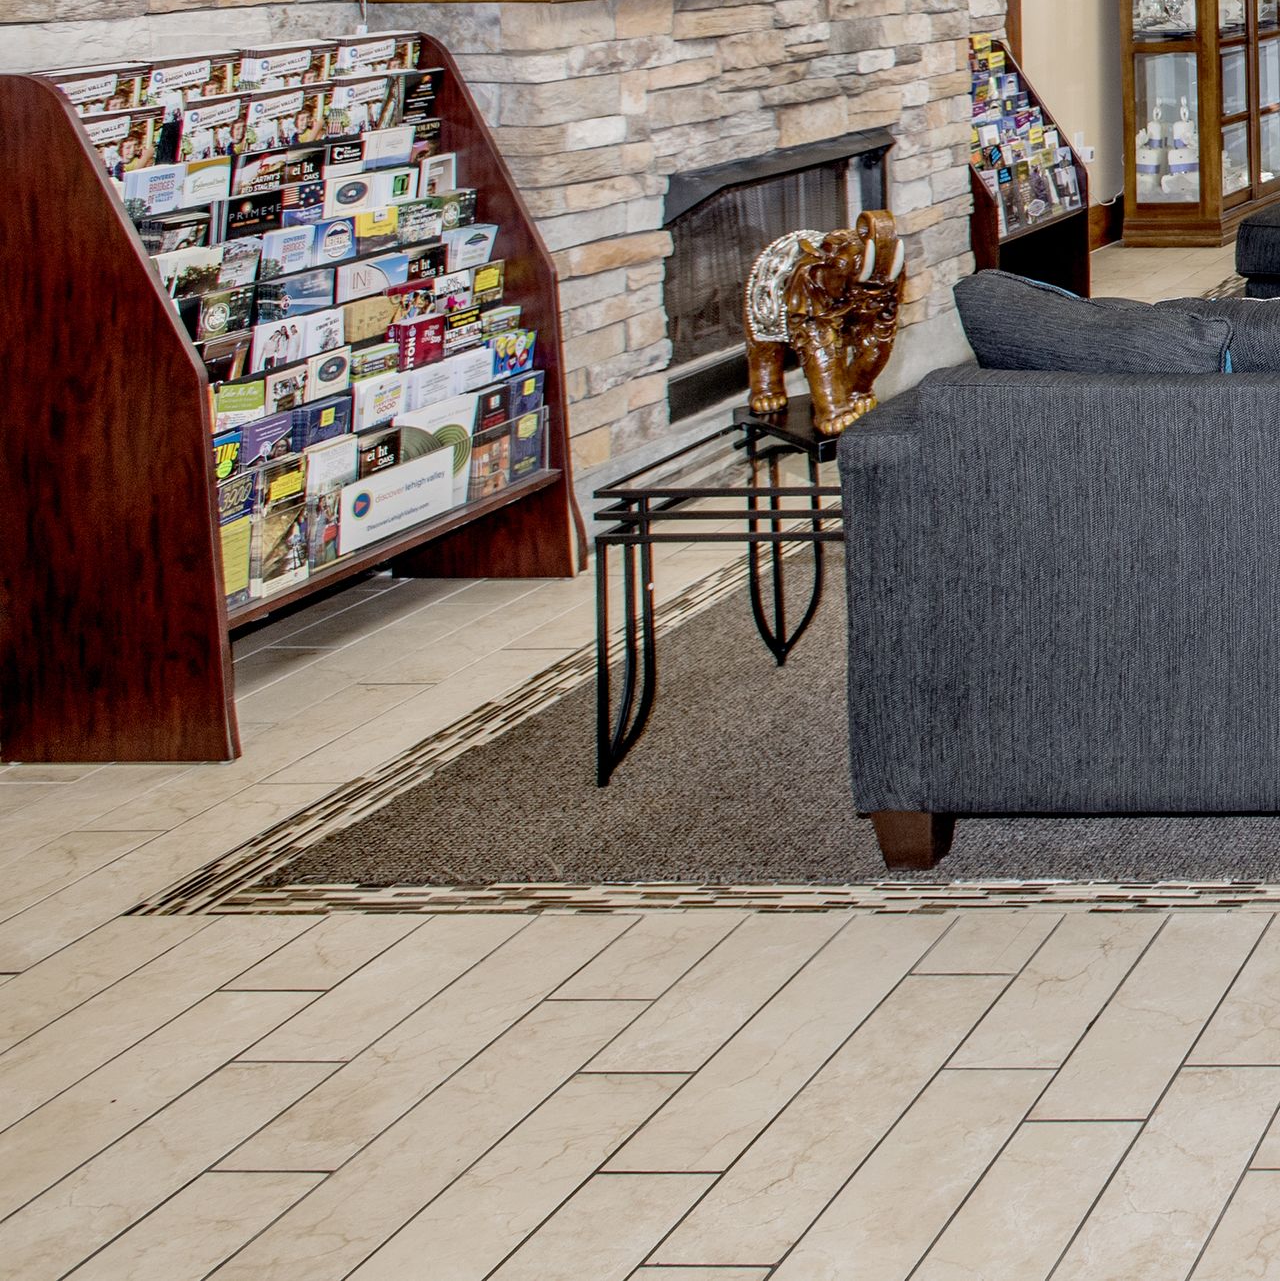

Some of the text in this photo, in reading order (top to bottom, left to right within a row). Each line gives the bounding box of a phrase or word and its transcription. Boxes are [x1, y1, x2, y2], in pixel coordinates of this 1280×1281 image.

[292, 162, 314, 176] eiht
[411, 259, 431, 273] eiht
[366, 445, 388, 461] eiht
